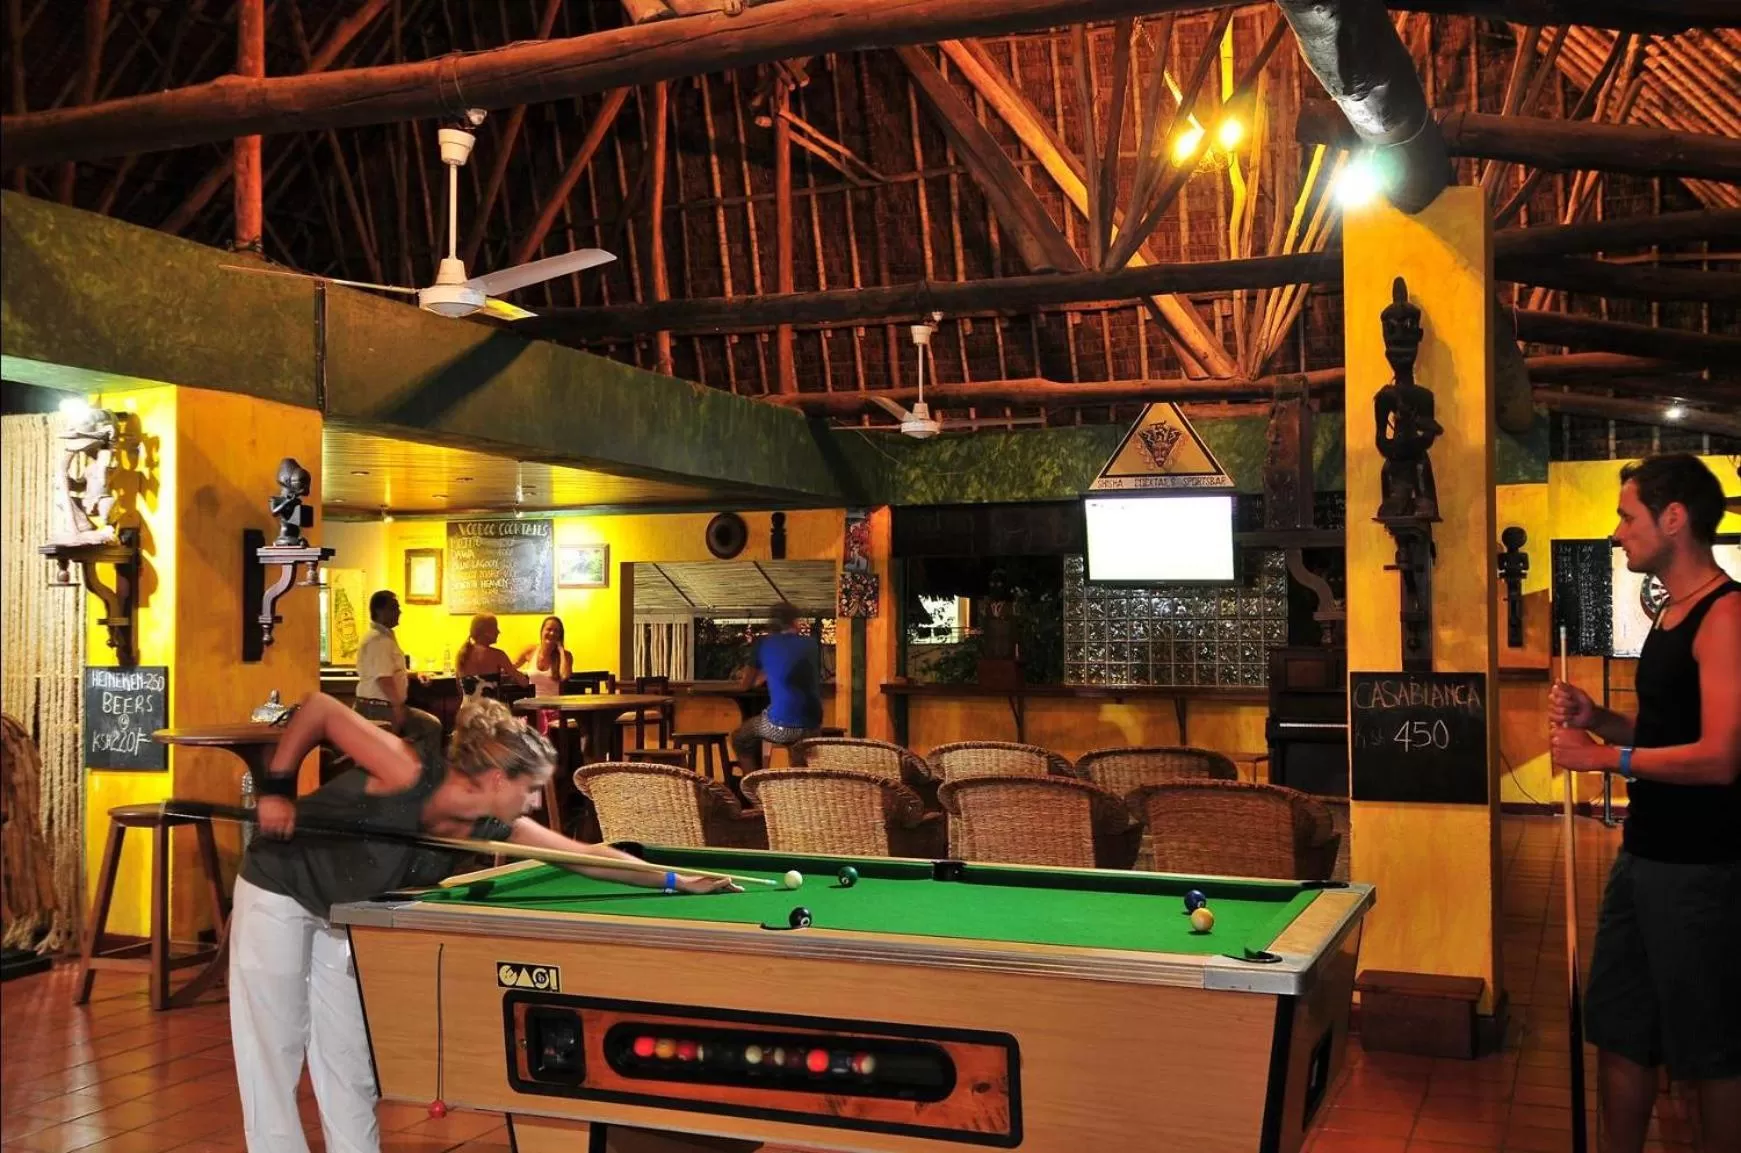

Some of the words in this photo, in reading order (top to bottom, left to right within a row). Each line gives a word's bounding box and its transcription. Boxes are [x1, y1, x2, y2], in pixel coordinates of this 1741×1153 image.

[102, 691, 154, 715] BEERS
[1353, 680, 1483, 709] CASABLANCA
[1393, 719, 1450, 752] 450
